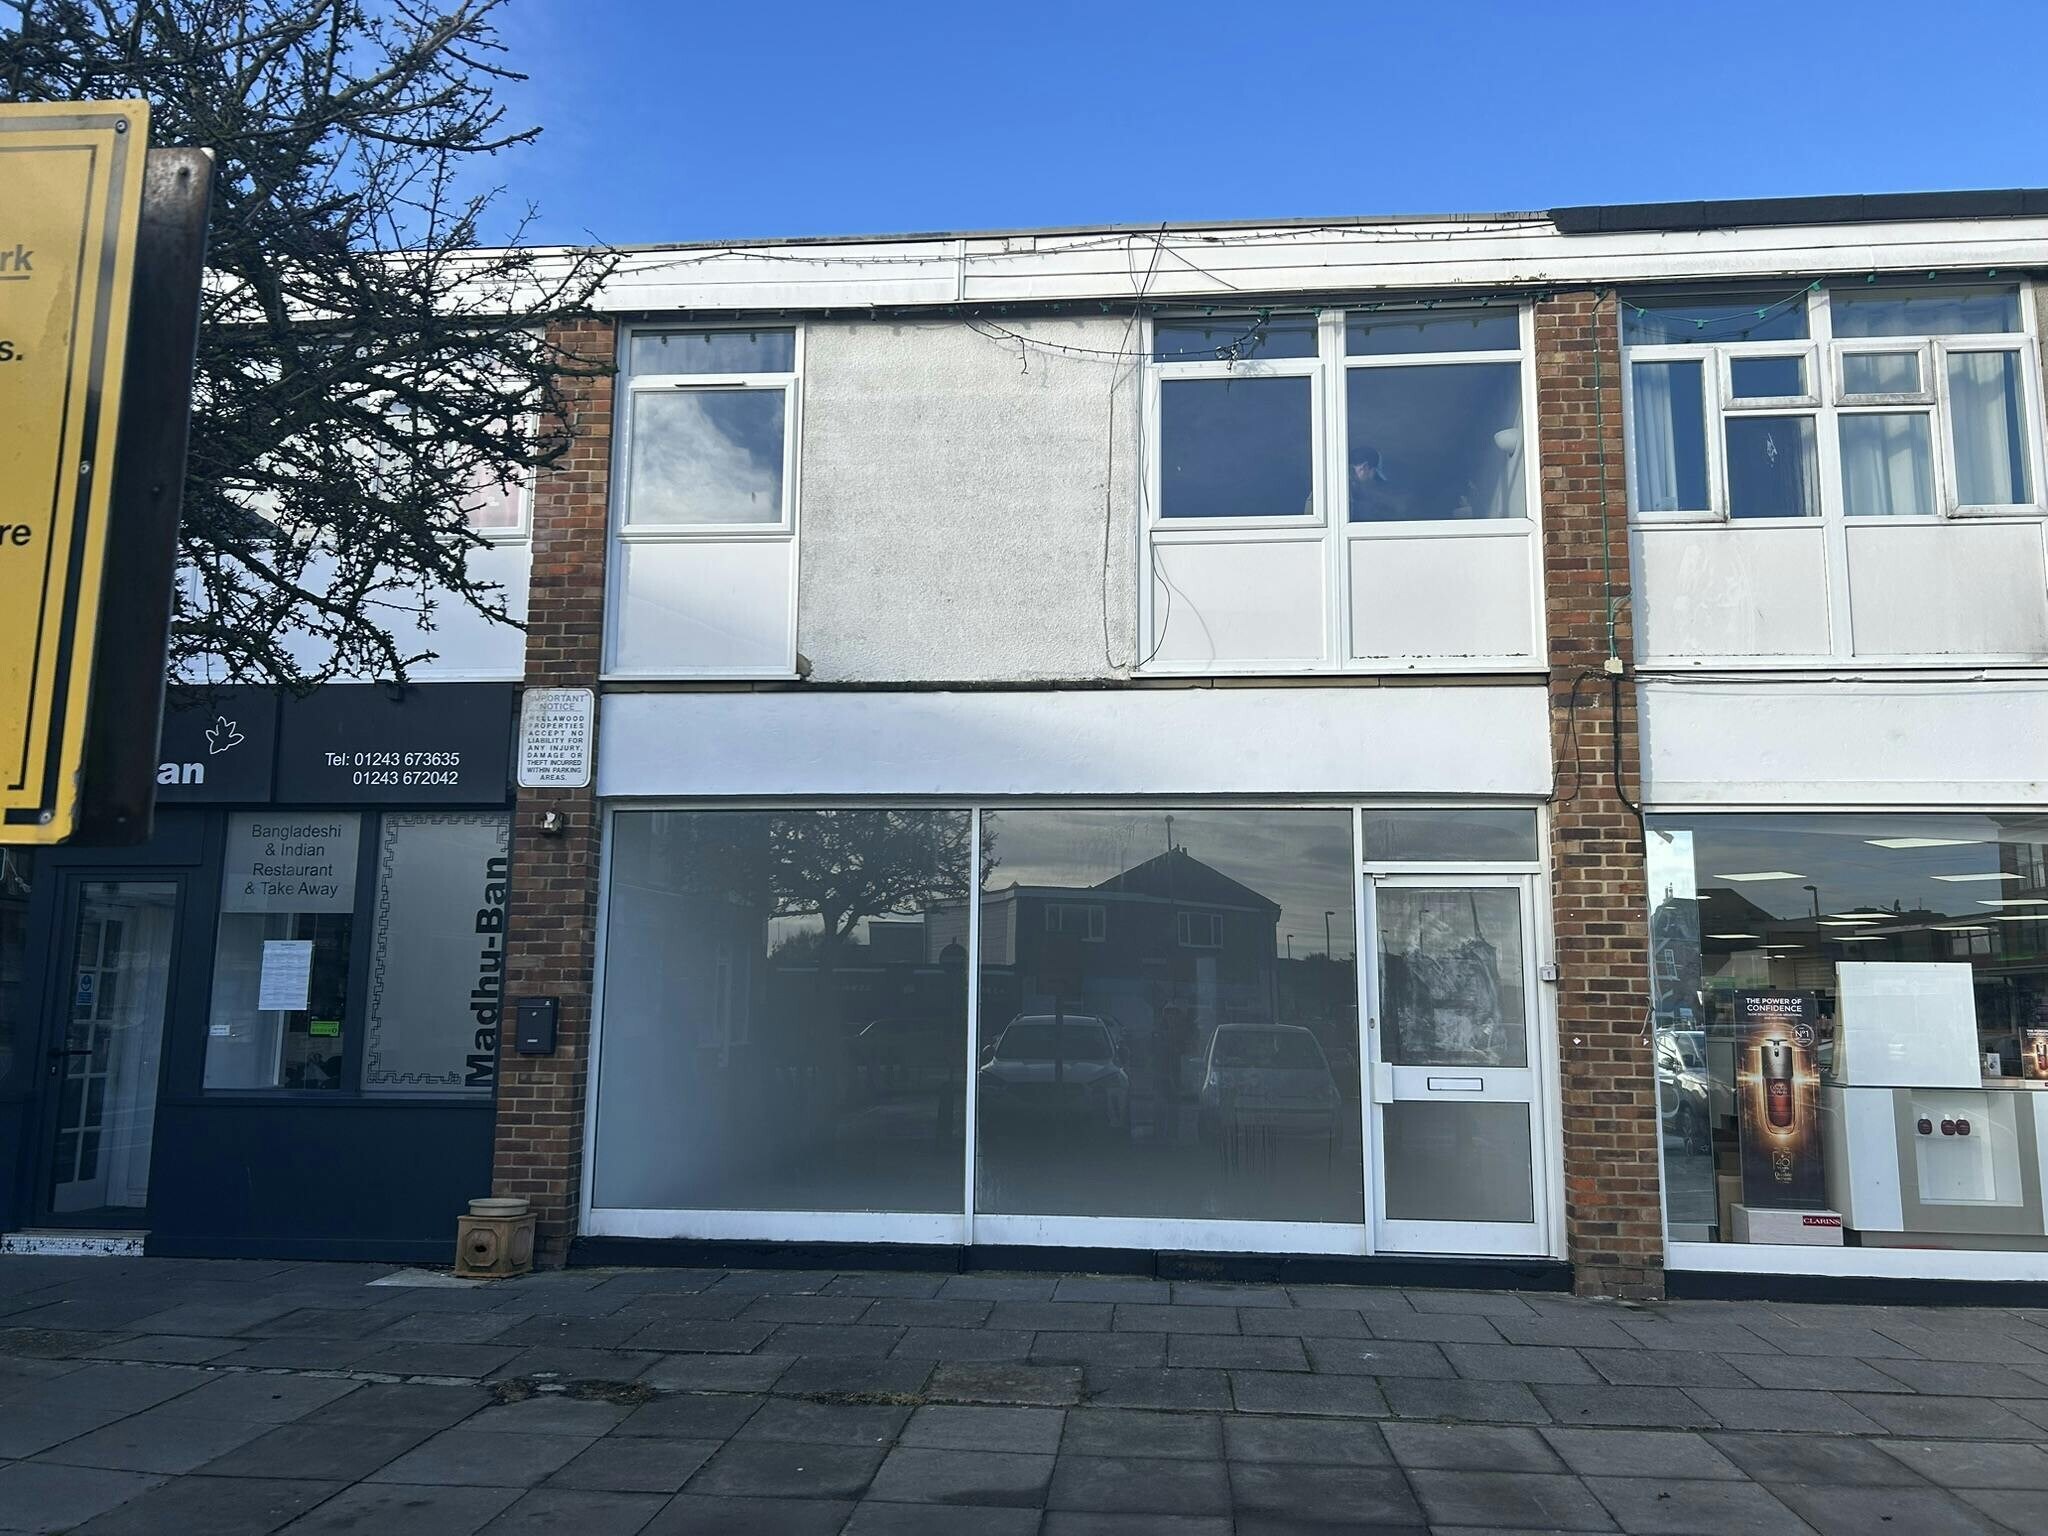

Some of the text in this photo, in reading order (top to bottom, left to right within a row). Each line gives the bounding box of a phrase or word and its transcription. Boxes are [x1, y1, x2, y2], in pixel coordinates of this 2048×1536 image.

[540, 702, 575, 711] NOTICE
[325, 752, 460, 766] Tel: 01243 673635
[353, 771, 459, 785] 01243 672042
[252, 824, 342, 841] Bangladeshi
[265, 842, 325, 856] & Indian
[252, 862, 333, 877] Restaurant
[244, 881, 338, 899] & Take Away
[464, 857, 508, 1087] Madhu-Ban
[1745, 997, 1761, 1005] THE
[1746, 1004, 1803, 1013] CONFIDENCE
[1803, 1217, 1841, 1225] CLARINS
